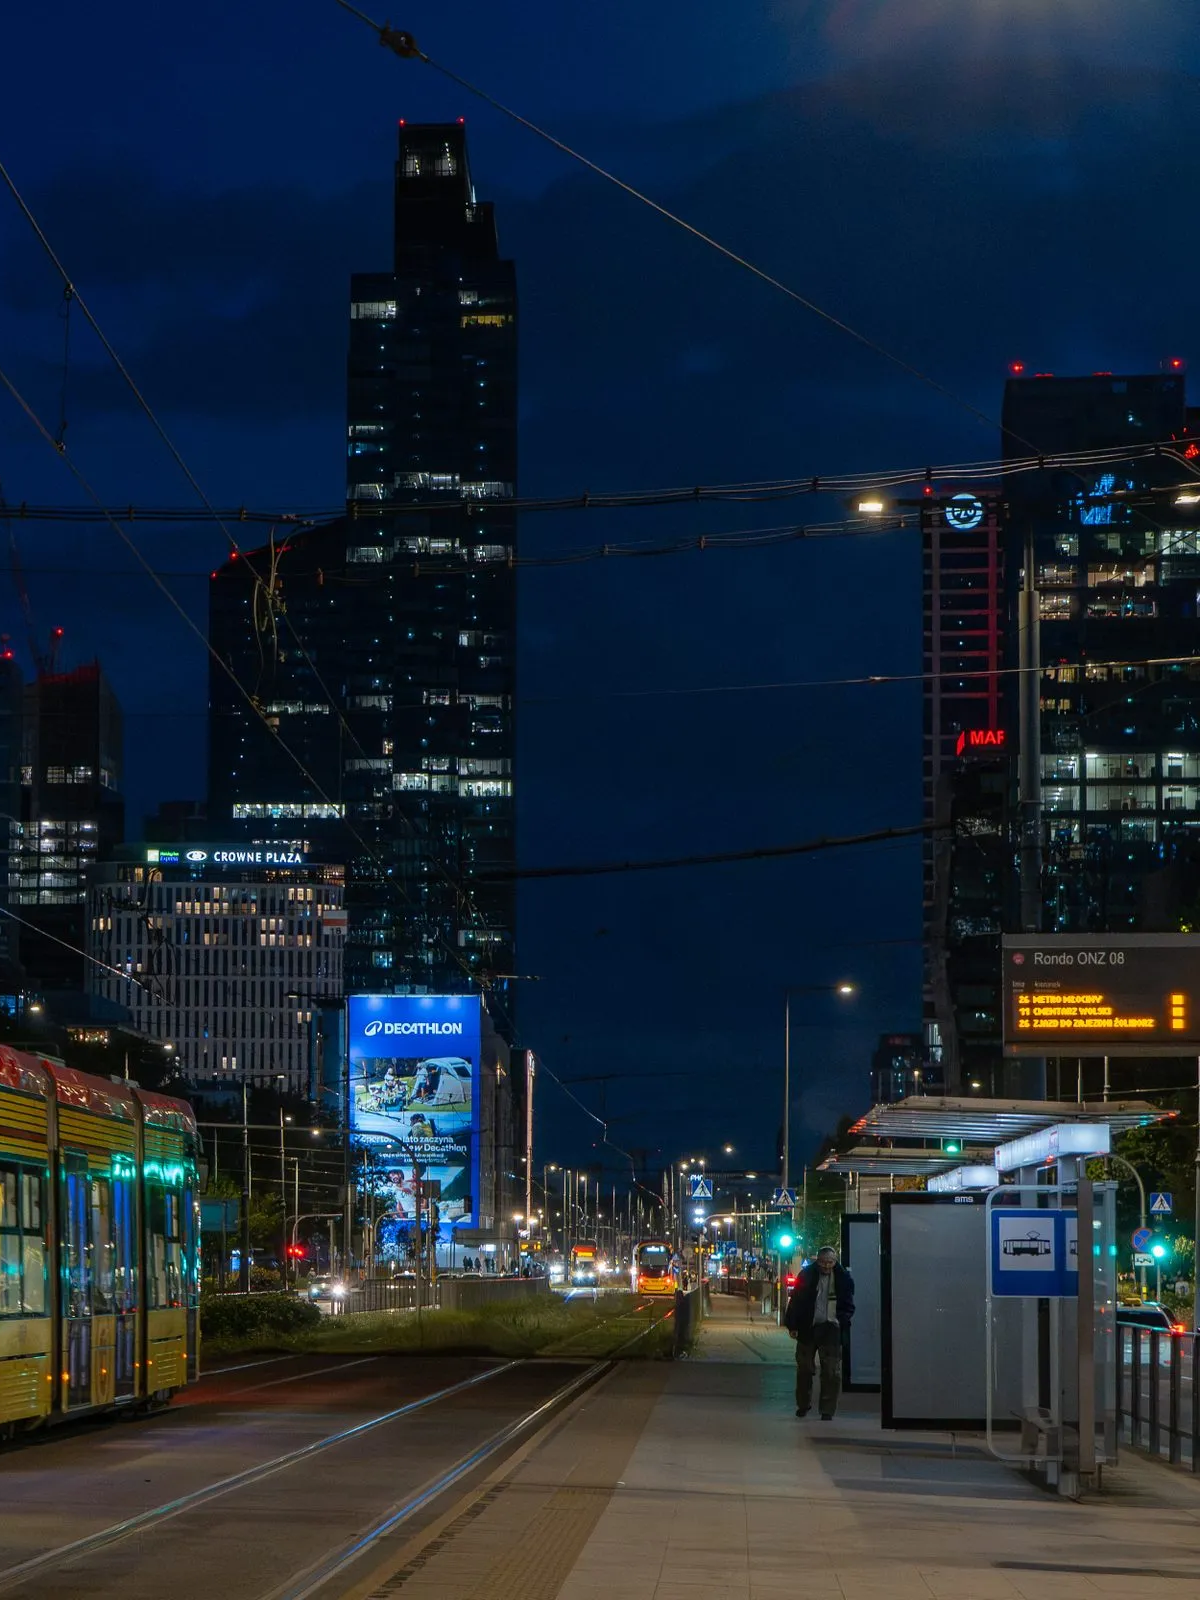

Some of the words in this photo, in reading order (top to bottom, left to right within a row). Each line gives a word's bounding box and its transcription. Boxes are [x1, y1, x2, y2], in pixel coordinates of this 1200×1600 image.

[213, 851, 261, 862] CROWNE
[266, 852, 301, 863] PLAZA
[1034, 952, 1073, 965] Rondo
[1077, 952, 1105, 965] ONZ
[1109, 952, 1125, 965] 08
[1018, 995, 1030, 1004] 26
[1032, 995, 1061, 1004] METRO
[1019, 1007, 1030, 1016] 11
[384, 1023, 462, 1034] DECATHLON
[424, 1143, 467, 1151] Decathlon
